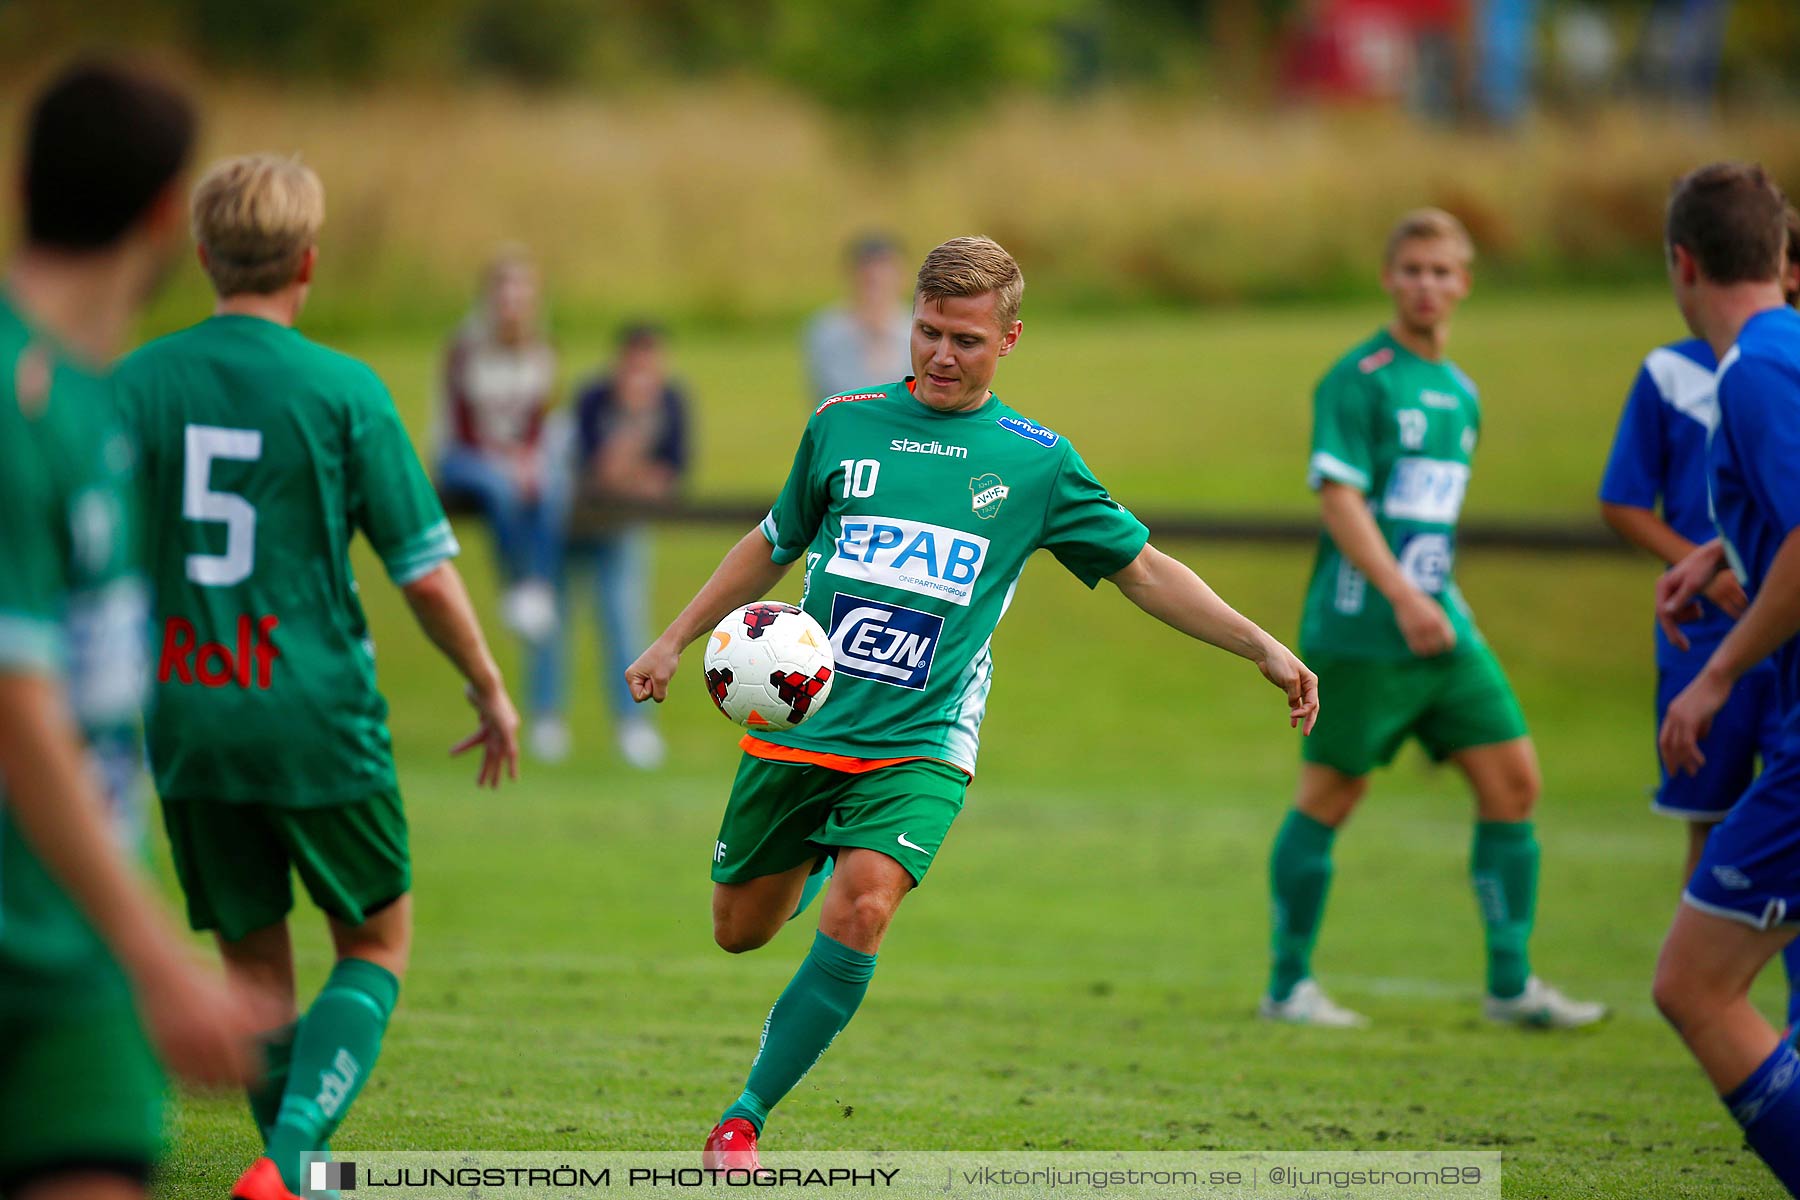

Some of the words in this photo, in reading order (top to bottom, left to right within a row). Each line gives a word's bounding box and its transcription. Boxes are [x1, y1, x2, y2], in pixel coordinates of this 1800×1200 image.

[839, 459, 881, 499] 10
[889, 438, 968, 459] stadium
[183, 424, 262, 586] 5
[838, 523, 982, 586] EPAB
[157, 613, 280, 690] Rolf
[829, 606, 932, 681] CEJN
